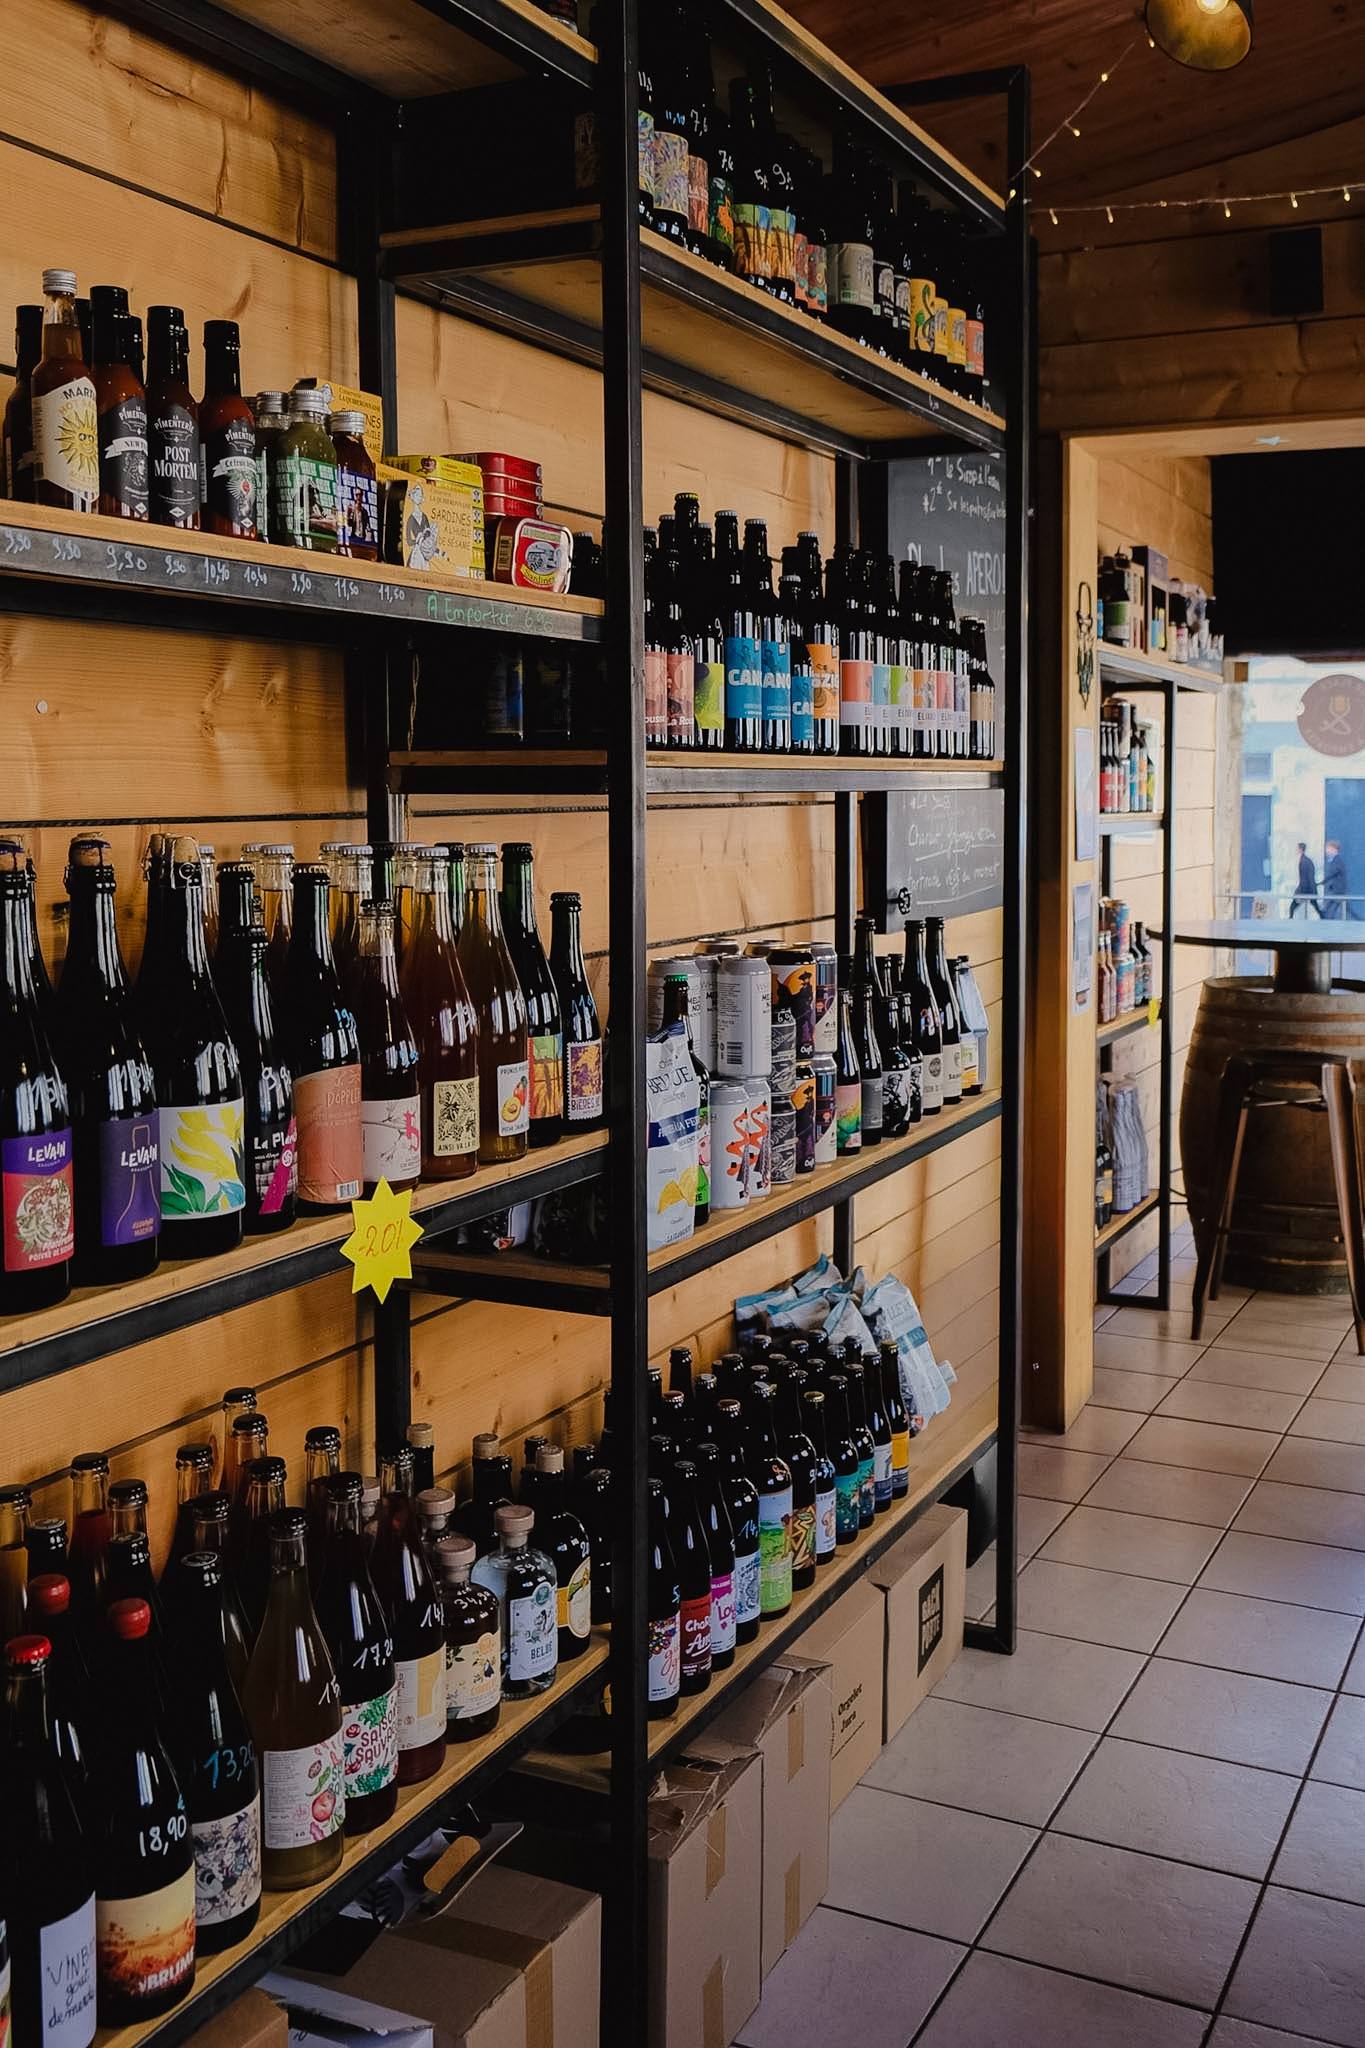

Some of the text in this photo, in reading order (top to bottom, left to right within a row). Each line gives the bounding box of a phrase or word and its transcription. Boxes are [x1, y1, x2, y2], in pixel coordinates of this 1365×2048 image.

[164, 445, 190, 463] POST
[154, 458, 197, 483] MORTEM
[431, 508, 471, 527] SARDINES
[27, 1141, 67, 1164] LEVAIN
[120, 1144, 159, 1168] LEVAIN
[139, 1814, 187, 1857] 18,90
